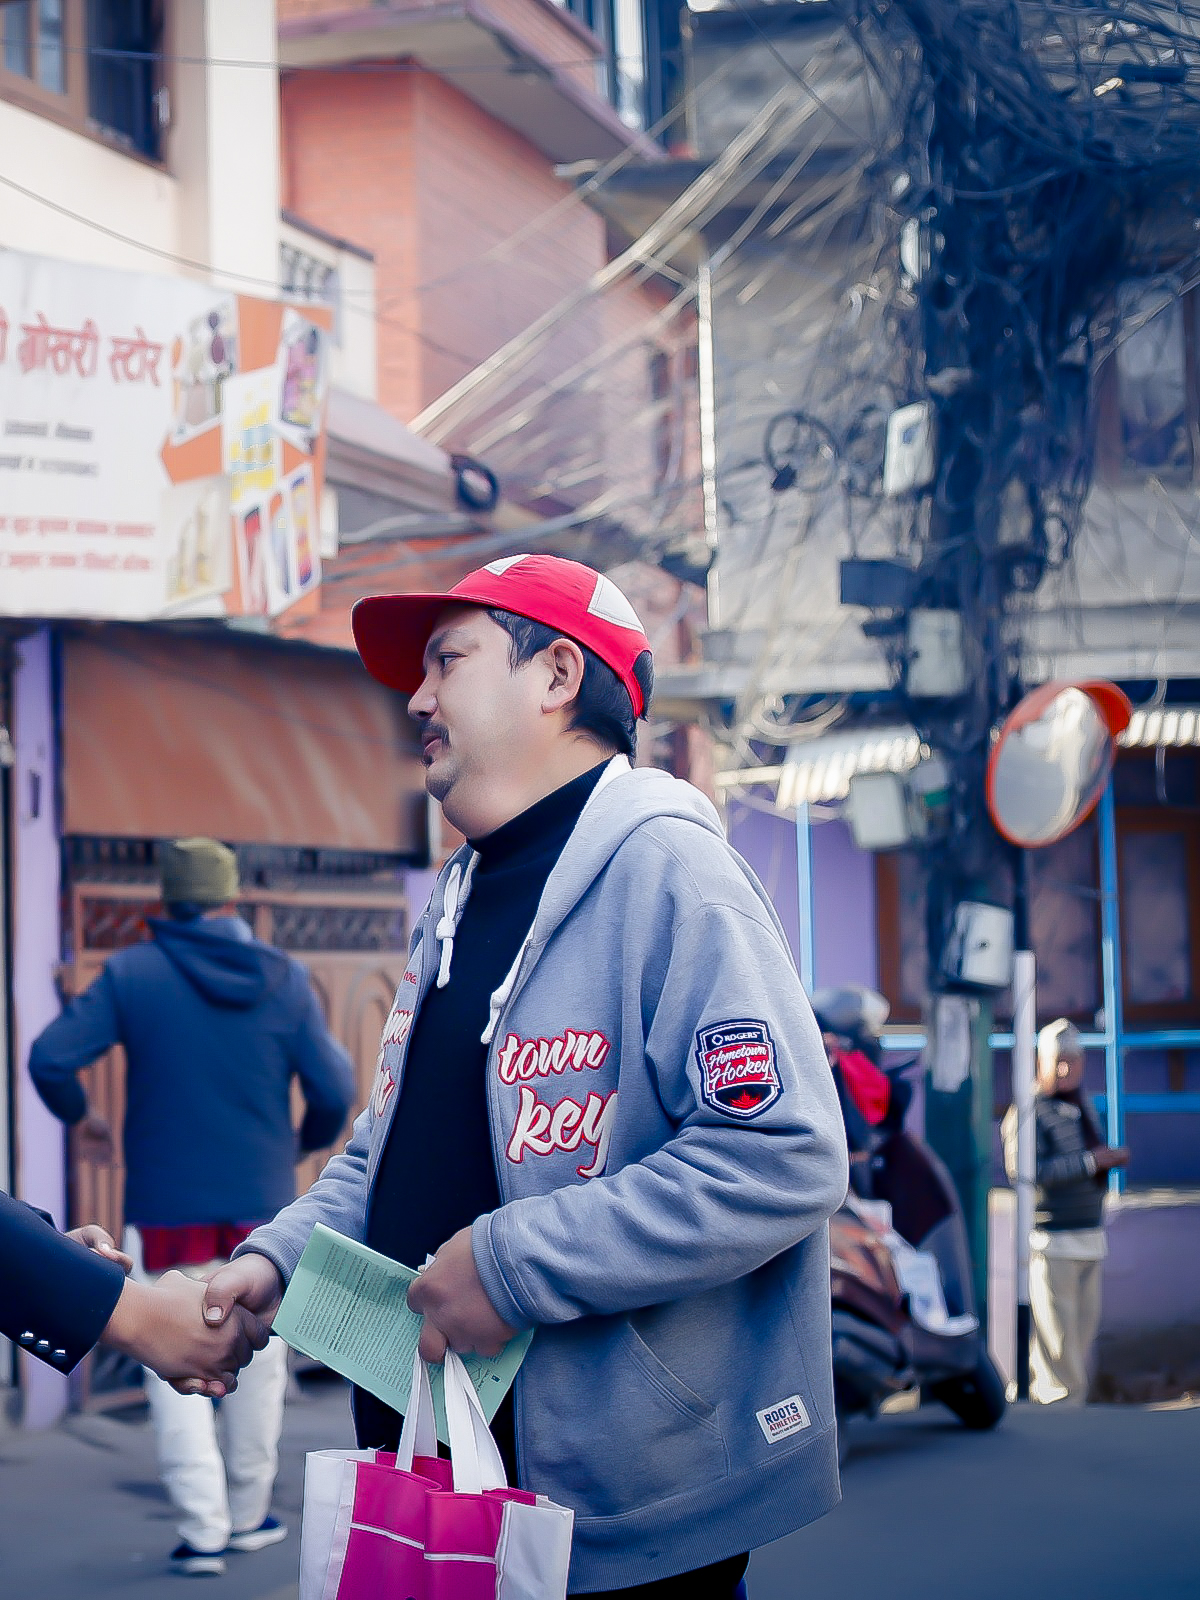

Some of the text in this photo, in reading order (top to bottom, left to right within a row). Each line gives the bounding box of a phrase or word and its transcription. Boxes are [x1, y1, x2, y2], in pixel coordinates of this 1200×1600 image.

[724, 1032, 760, 1042] ROGERS
[498, 1028, 611, 1085] town
[707, 1045, 767, 1070] Hometown
[707, 1057, 773, 1091] Hockey
[506, 1085, 618, 1179] key
[764, 1402, 799, 1426] ROOTS
[770, 1413, 802, 1432] ATHLETICS
